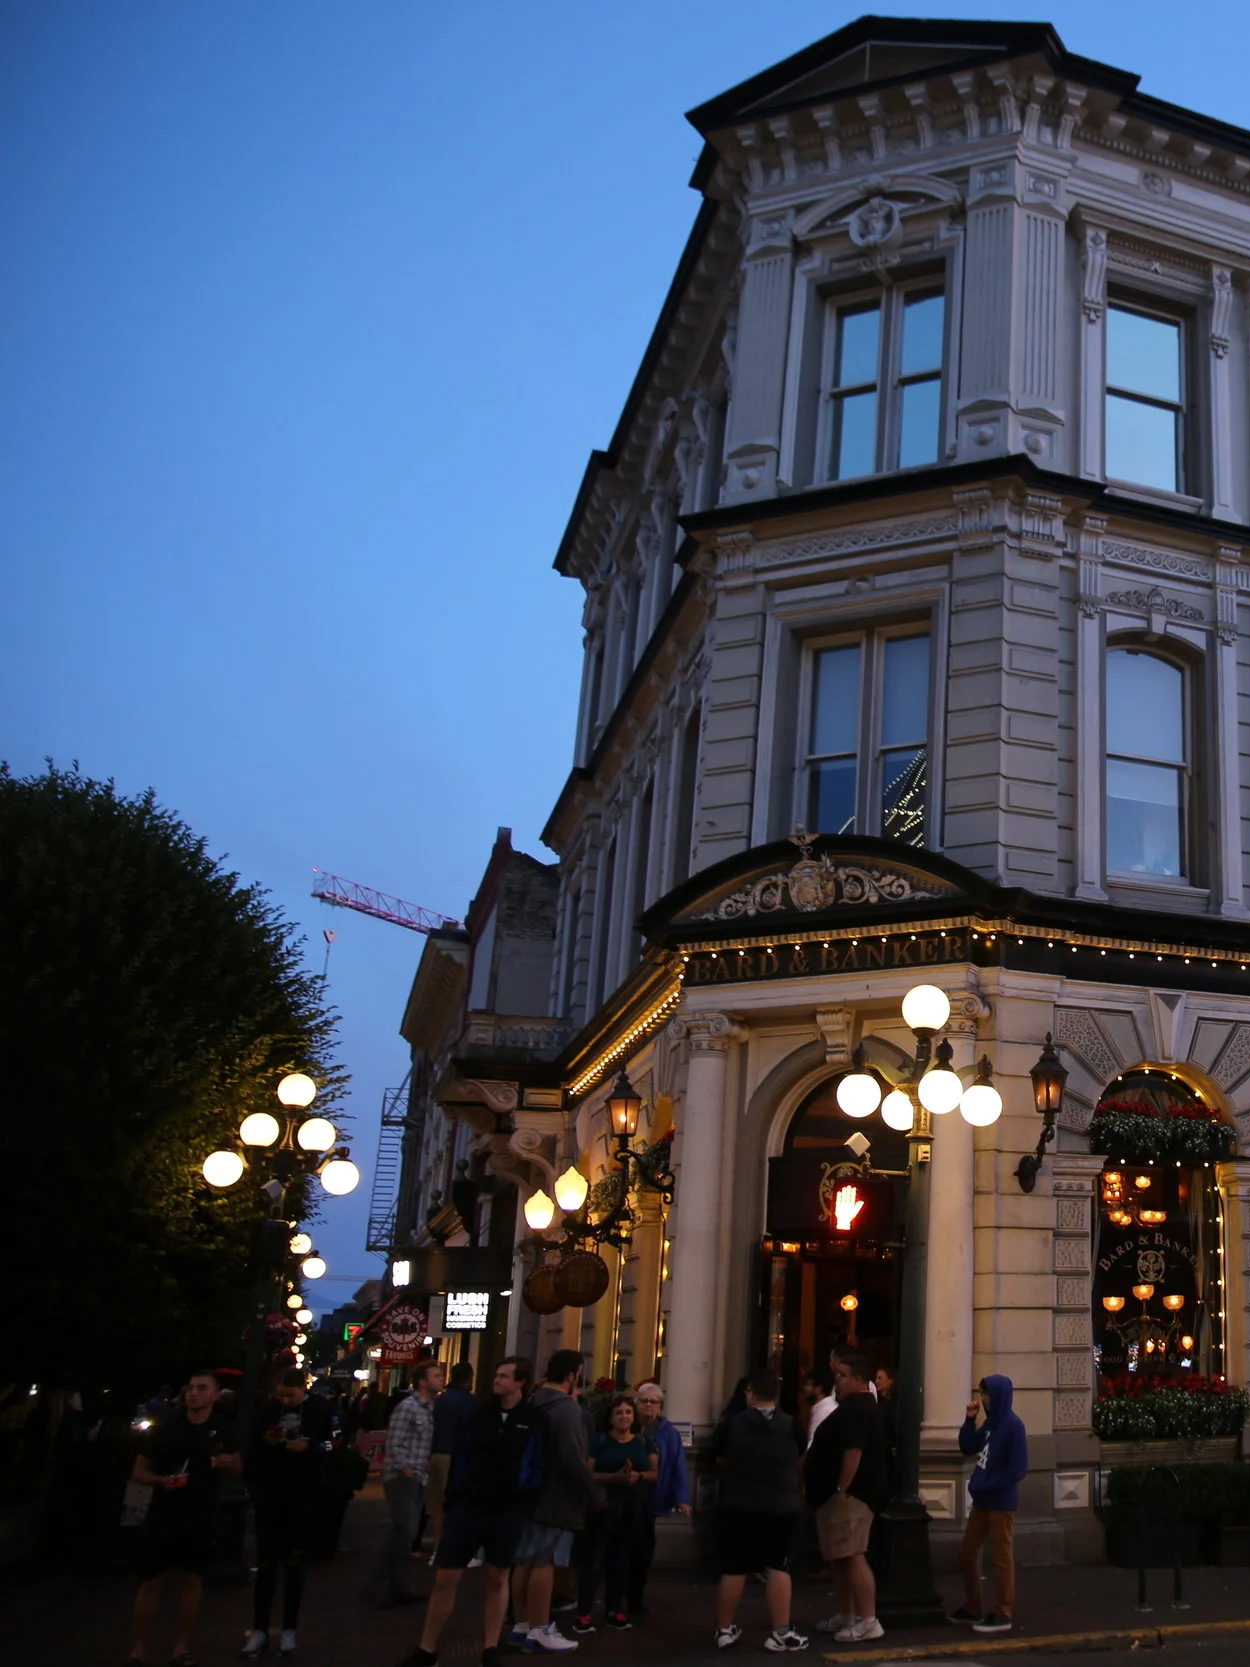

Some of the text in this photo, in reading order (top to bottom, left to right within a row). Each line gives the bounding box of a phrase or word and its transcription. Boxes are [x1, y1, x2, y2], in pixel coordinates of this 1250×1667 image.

[692, 935, 967, 984] BARD & BANKER
[1098, 1239, 1134, 1272] BARD
[1137, 1233, 1150, 1246] &
[385, 1305, 426, 1322] SAVE ON
